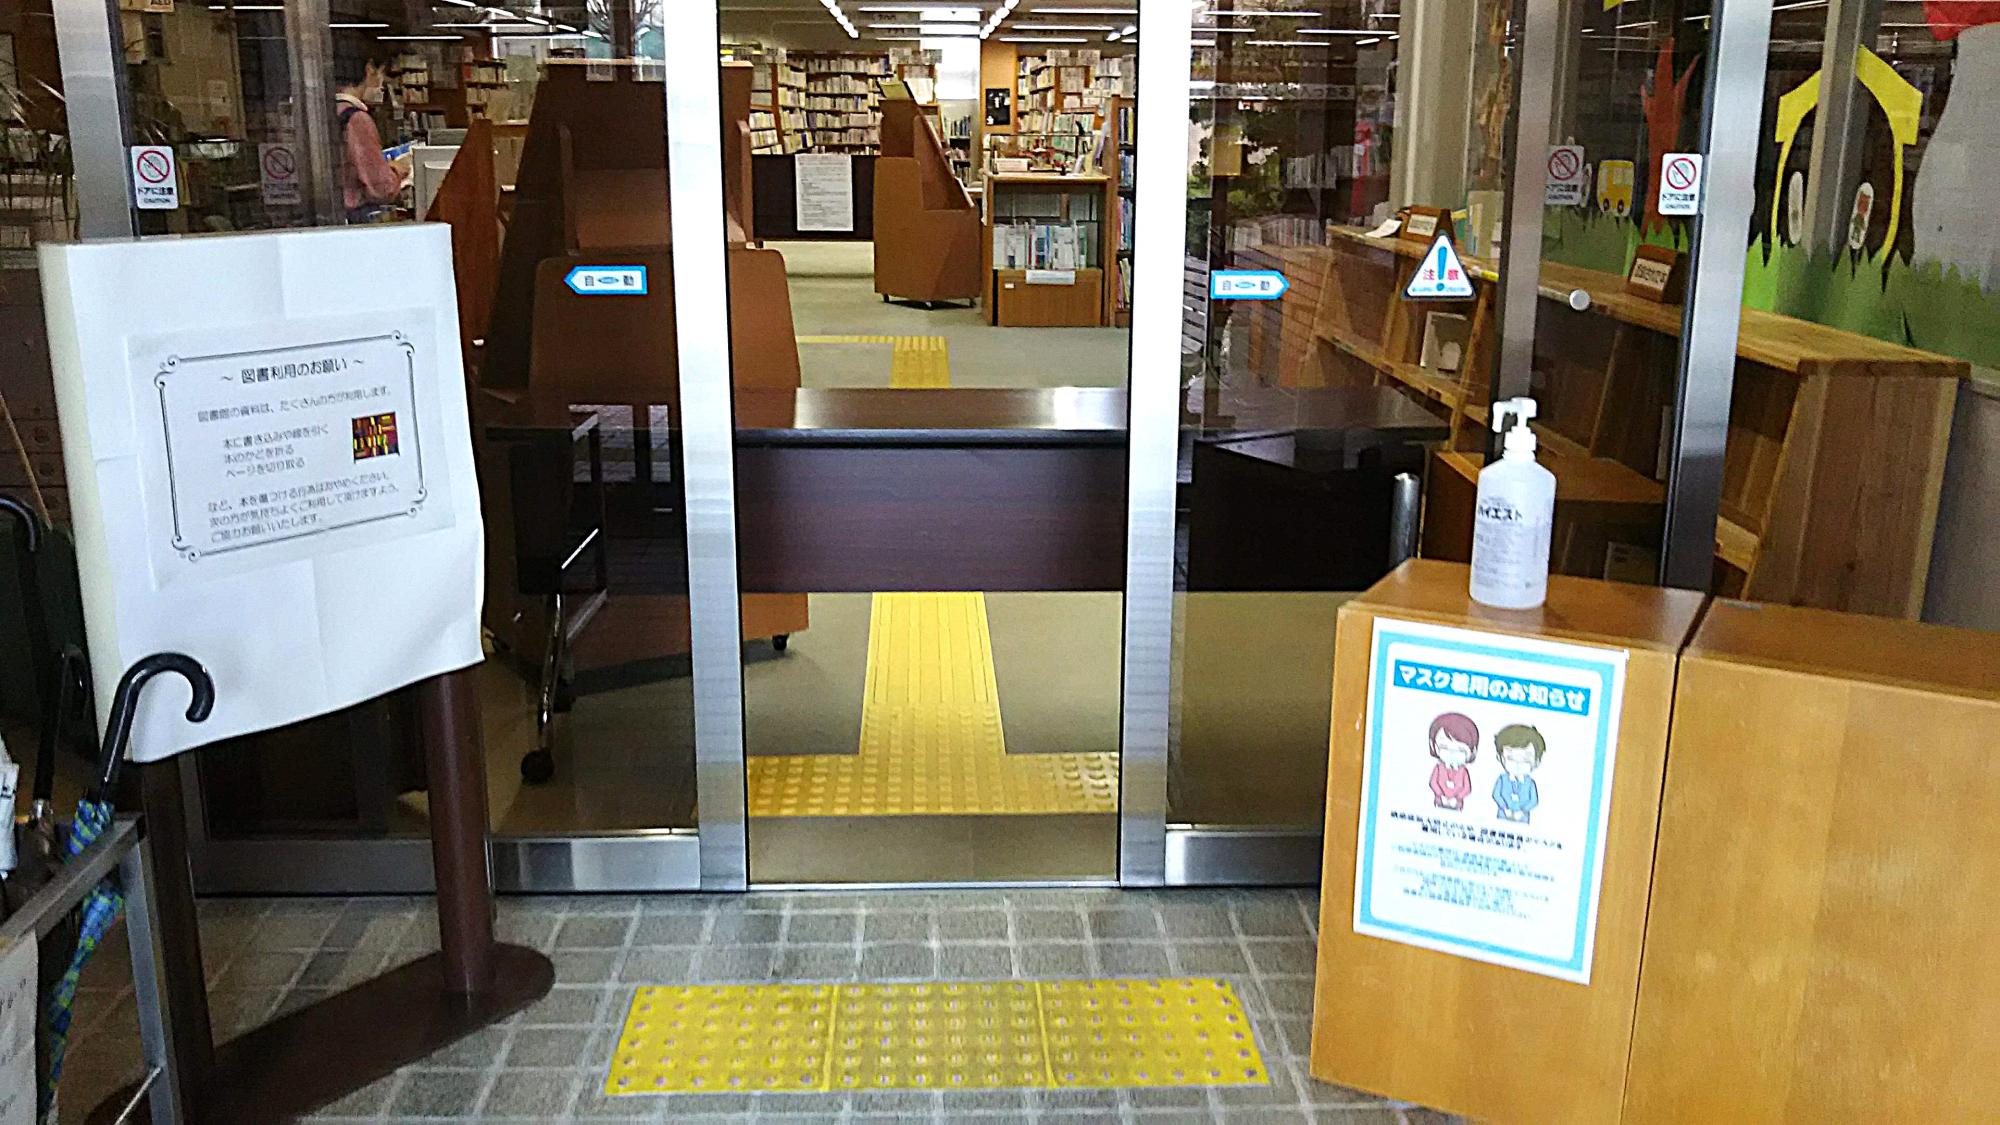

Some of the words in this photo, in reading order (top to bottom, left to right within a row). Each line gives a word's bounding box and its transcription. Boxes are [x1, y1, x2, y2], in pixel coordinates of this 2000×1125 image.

[137, 186, 174, 196] ドアに注意
[1662, 193, 1696, 202] ドアに注意
[241, 358, 348, 384] 図書利用のお願い
[223, 423, 329, 449] 本に書き込みや線を引く
[225, 445, 295, 464] 本のかどを折る
[226, 459, 305, 478] ページを切り取る
[1477, 504, 1523, 521] ハイエスト
[1399, 664, 1586, 712] マスク着用のお知らせ
